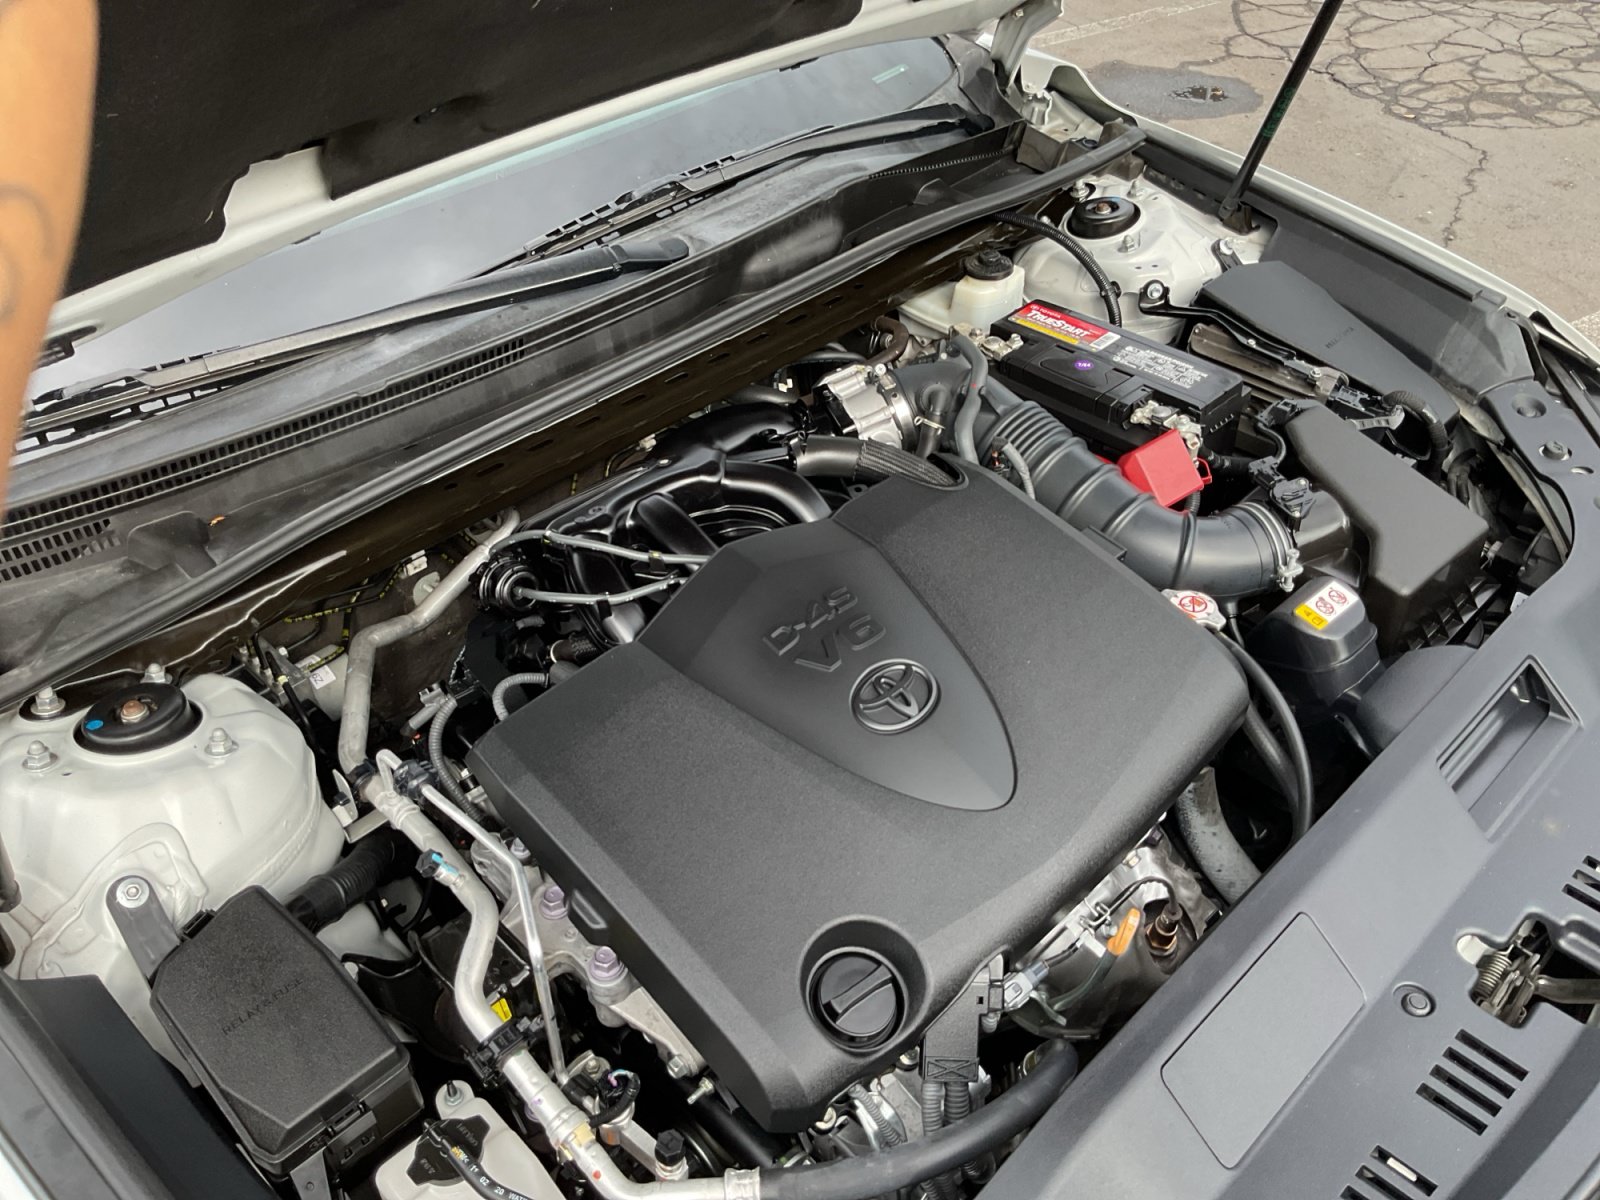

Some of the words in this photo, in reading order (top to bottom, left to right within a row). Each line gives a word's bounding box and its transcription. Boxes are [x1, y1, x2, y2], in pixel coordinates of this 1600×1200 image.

[793, 613, 887, 672] V6
[222, 1004, 263, 1035] RELAY
[272, 977, 304, 1000] FUSE
